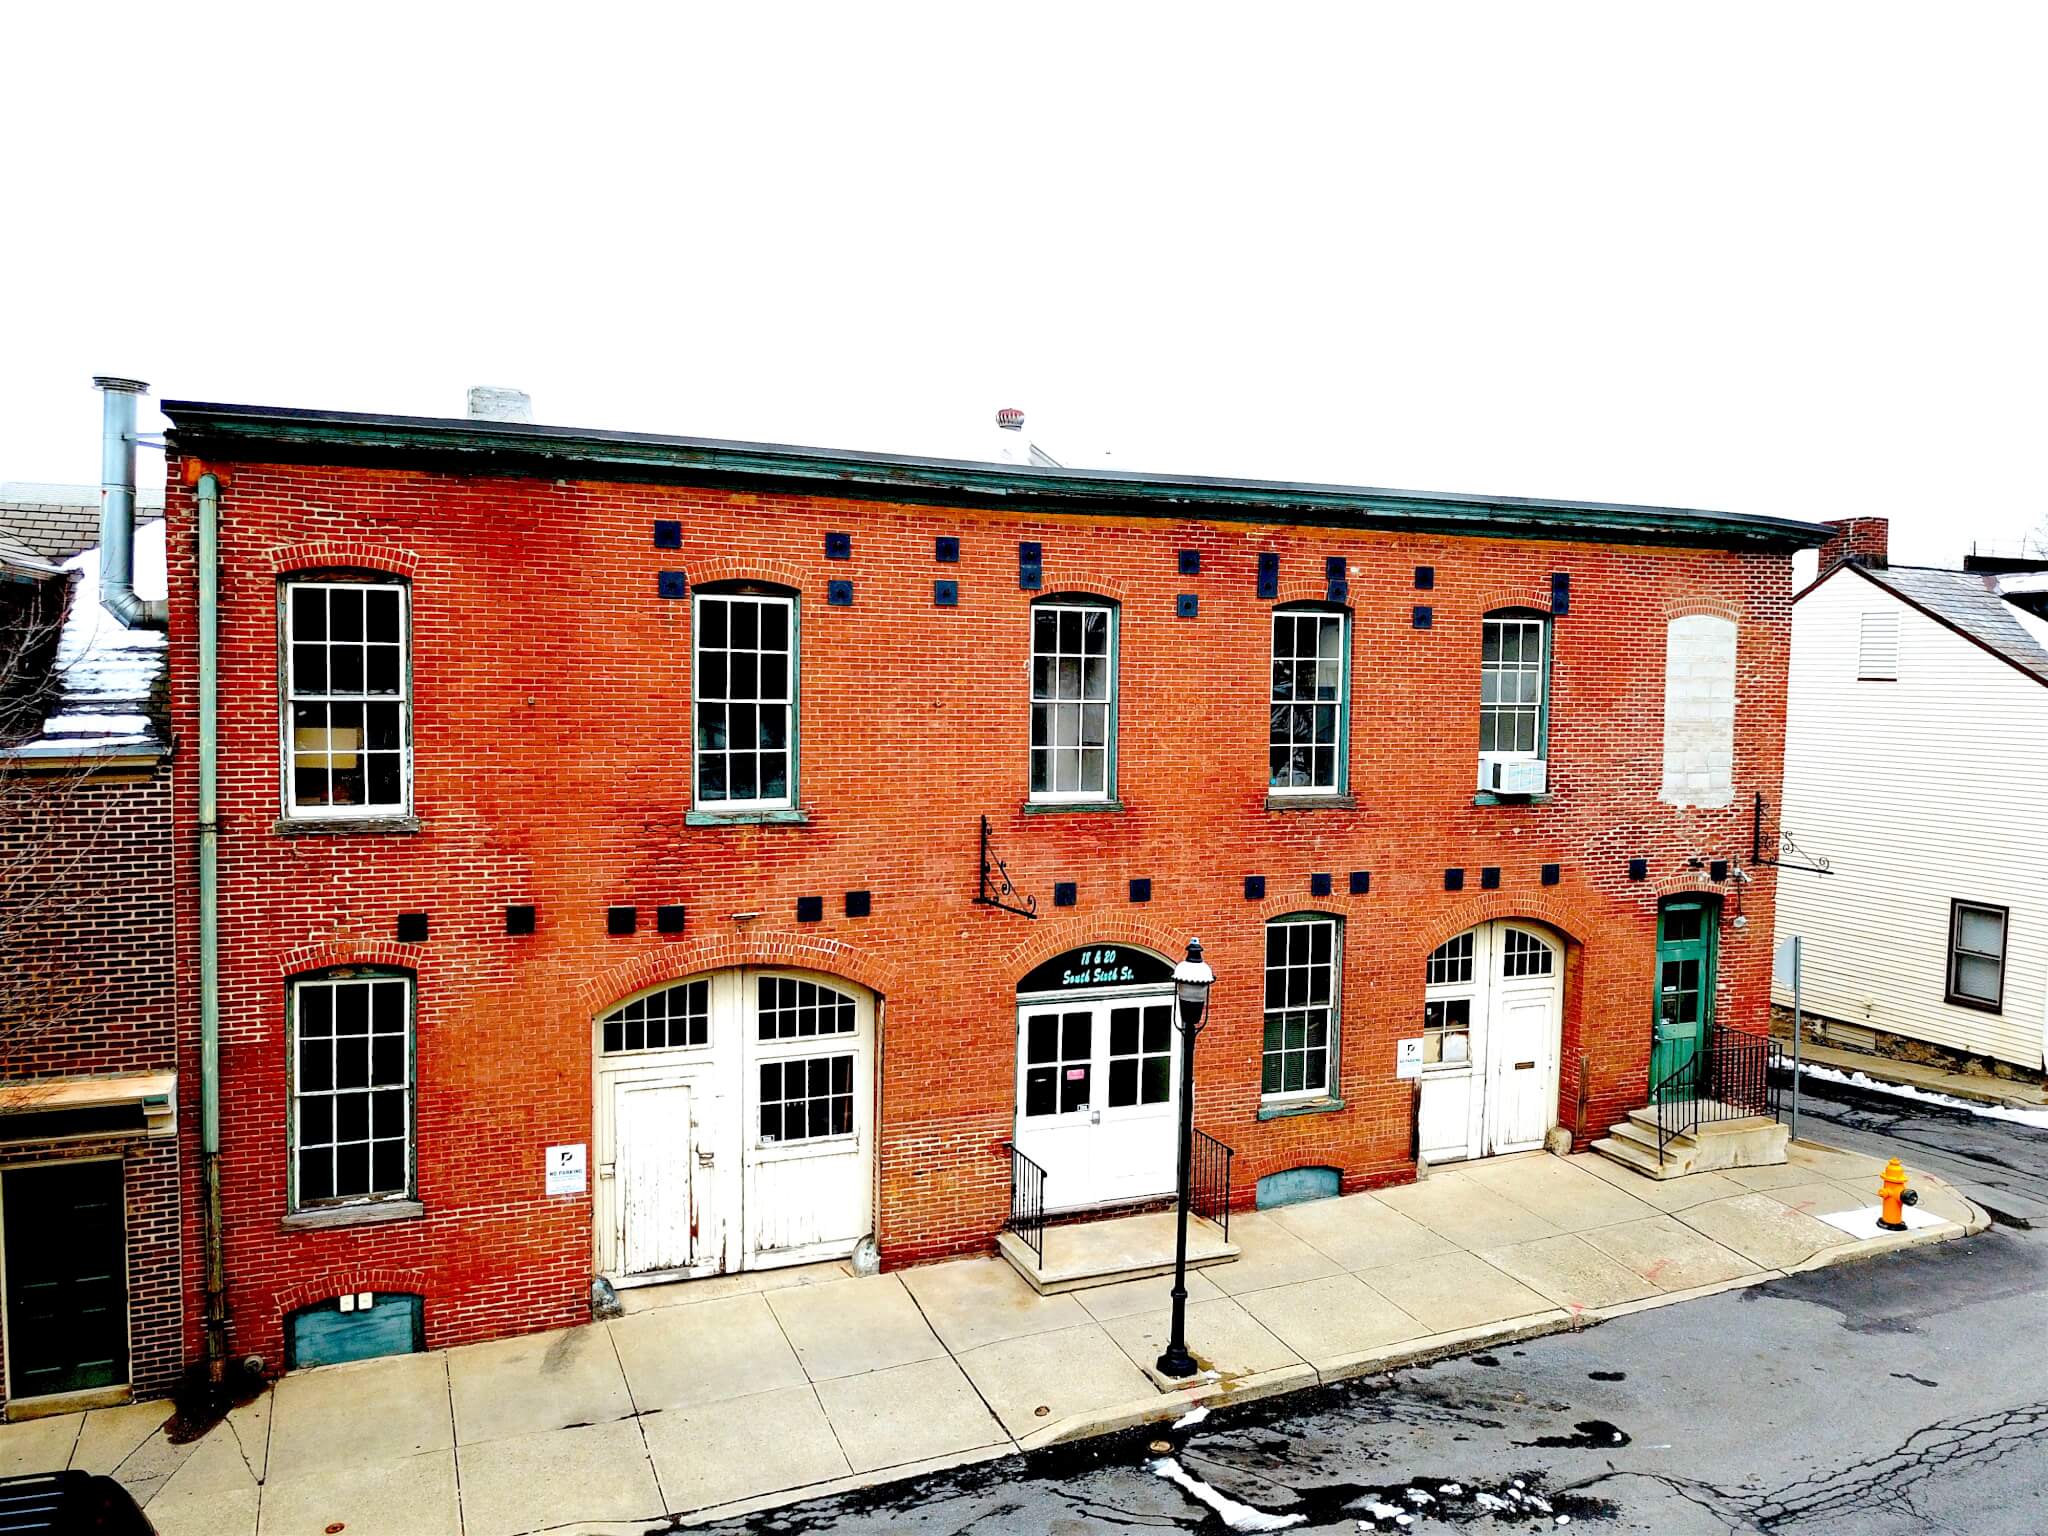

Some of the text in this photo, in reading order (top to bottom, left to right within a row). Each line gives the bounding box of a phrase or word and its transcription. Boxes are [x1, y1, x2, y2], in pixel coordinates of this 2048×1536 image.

[1081, 951, 1092, 966] 18
[1103, 949, 1116, 964] 20
[1062, 966, 1135, 985] South Sixth St.
